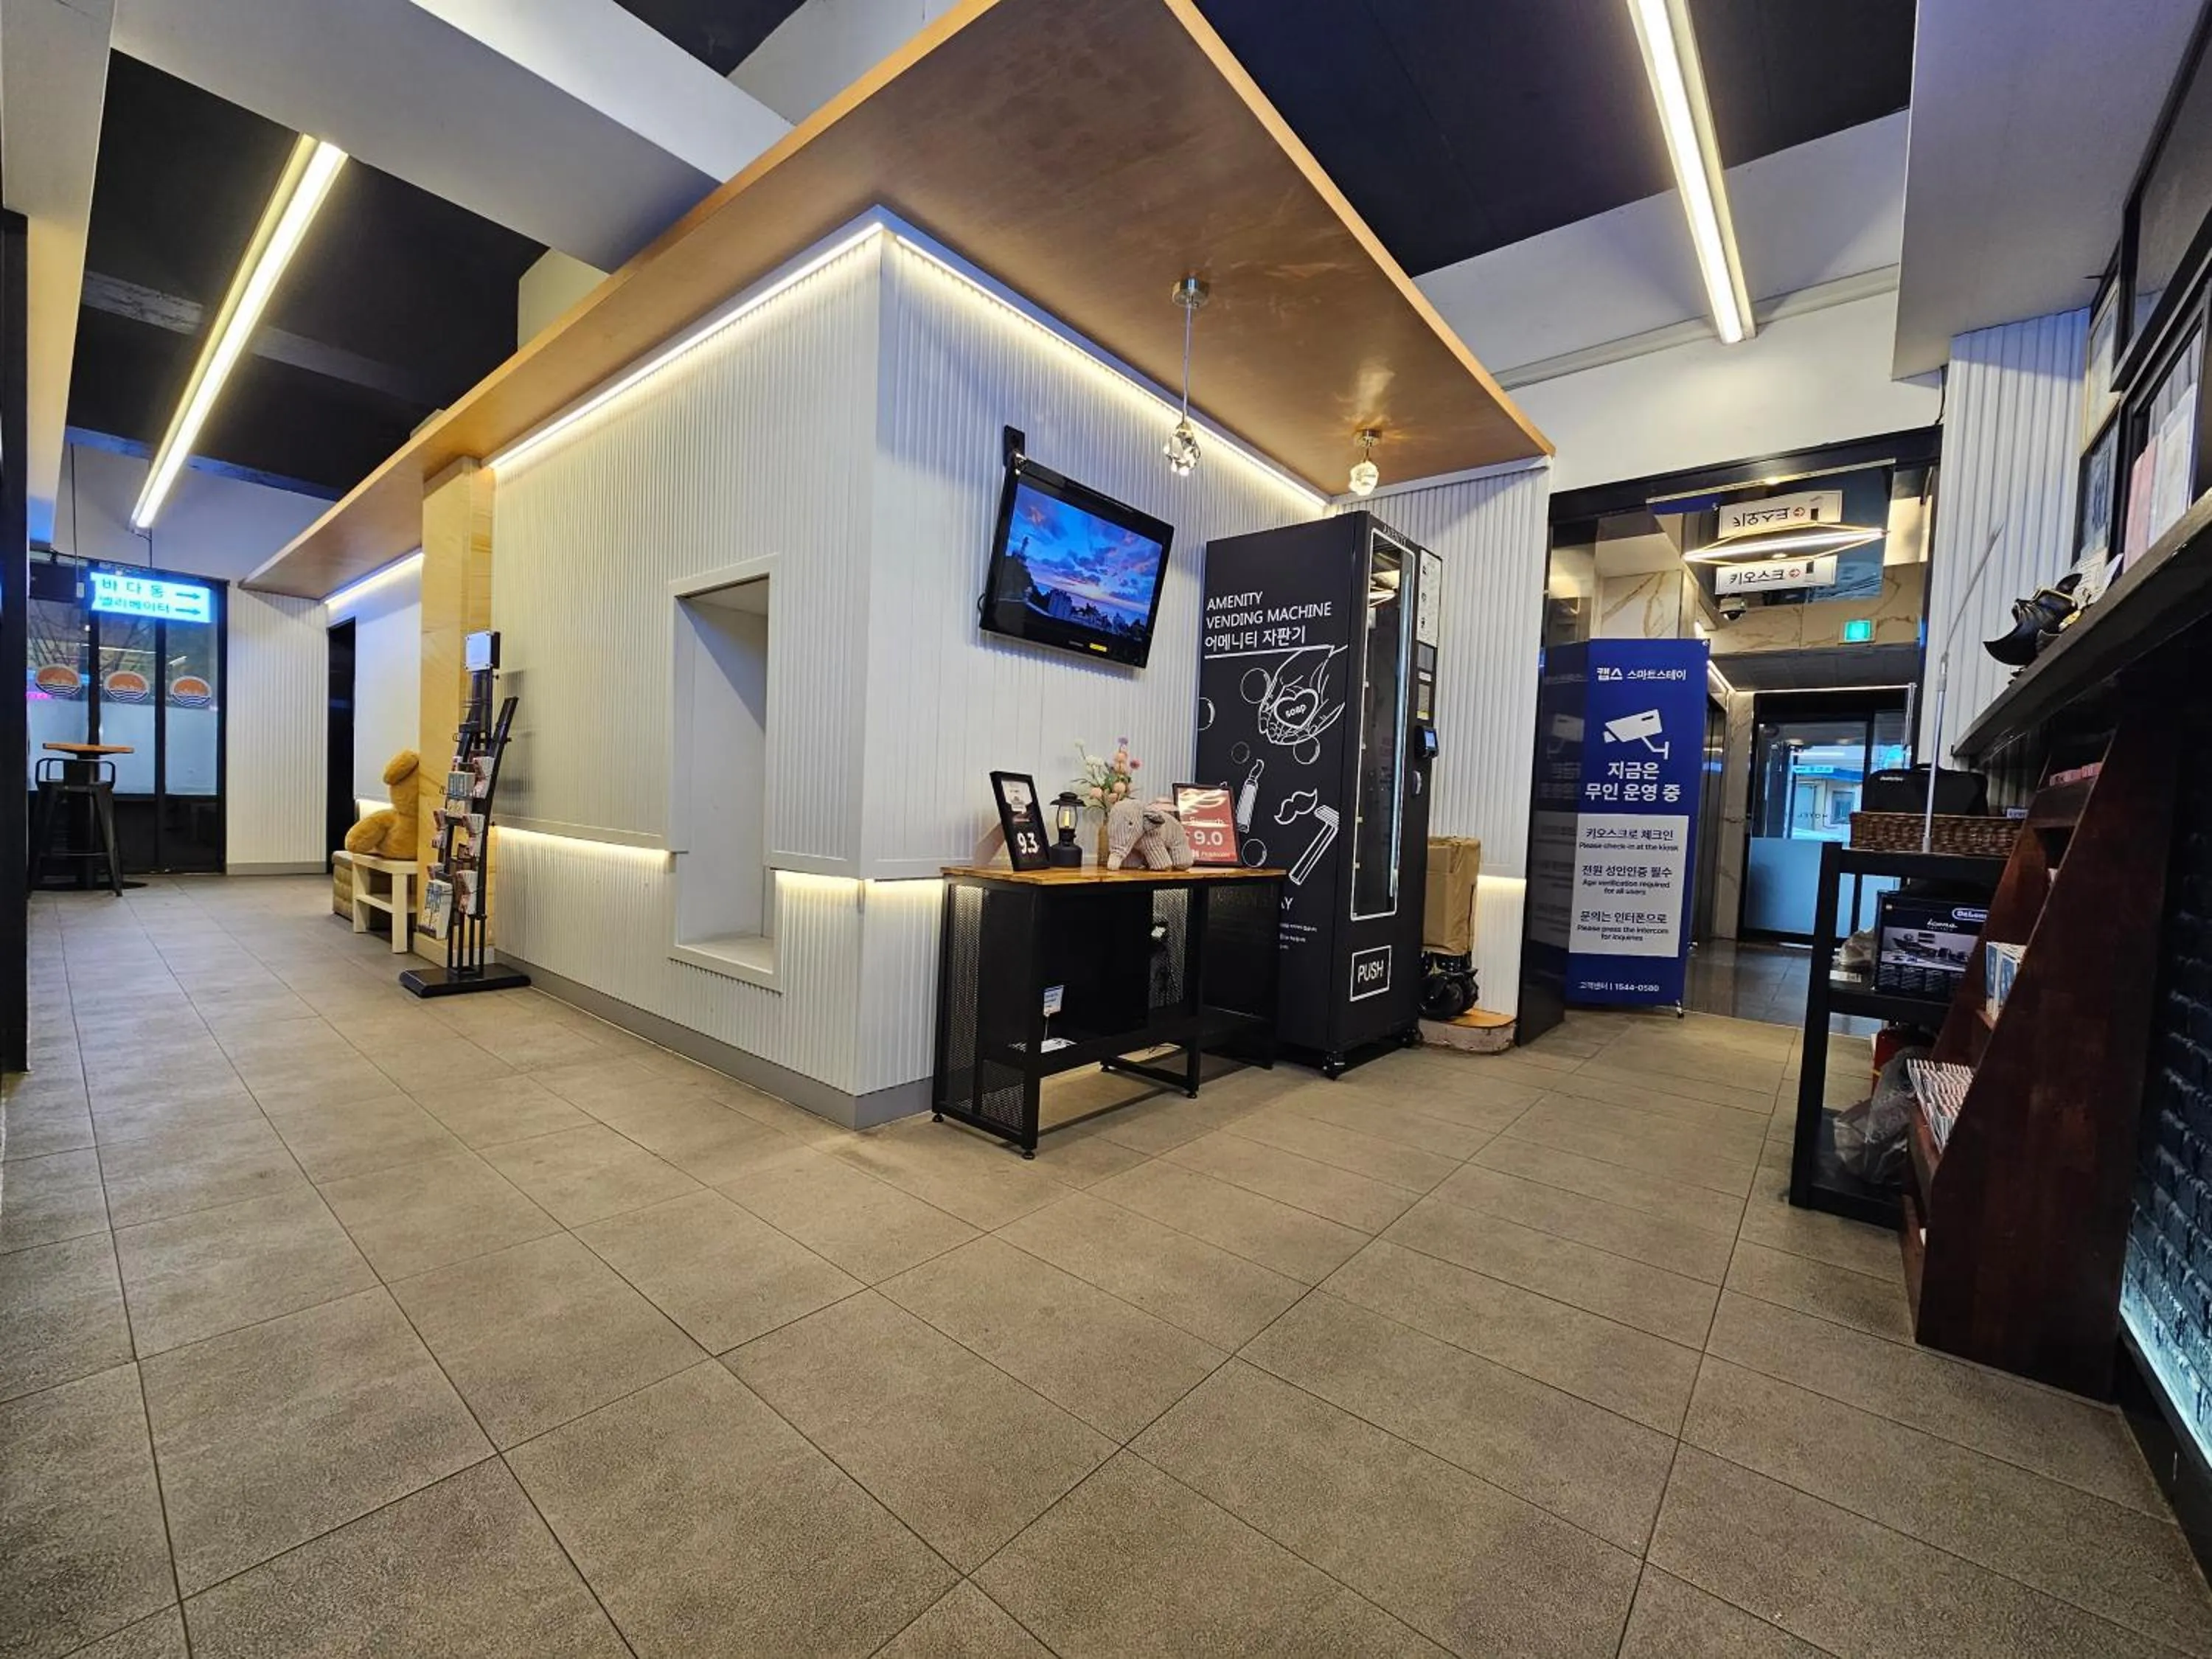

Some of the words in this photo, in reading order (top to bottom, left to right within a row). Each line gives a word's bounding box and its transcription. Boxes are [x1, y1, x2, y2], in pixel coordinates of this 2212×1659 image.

[1730, 569, 1785, 585] 키오스크
[1206, 591, 1263, 611] AMENITY
[1206, 611, 1263, 629] VENDING
[1267, 602, 1332, 622] MACHINE
[1205, 630, 1258, 652] 어메니티
[1262, 625, 1306, 647] 자판기
[1596, 667, 1622, 681] 캡스
[1627, 669, 1686, 681] 스마트스테이
[1607, 760, 1660, 779] 지금은
[1585, 782, 1618, 801] 무인
[1623, 783, 1658, 802] 운영
[1661, 783, 1681, 802] 중
[1194, 830, 1222, 845] 9.0
[1586, 828, 1638, 839] 키오스크로
[1641, 830, 1674, 841] 체크인
[1582, 865, 1602, 876] 전원
[1605, 865, 1647, 877] 성인인증
[1651, 866, 1672, 877] 필수
[1580, 911, 1611, 922] 문의는
[1614, 912, 1667, 923] 인터폰으로
[1357, 959, 1384, 983] PUSH
